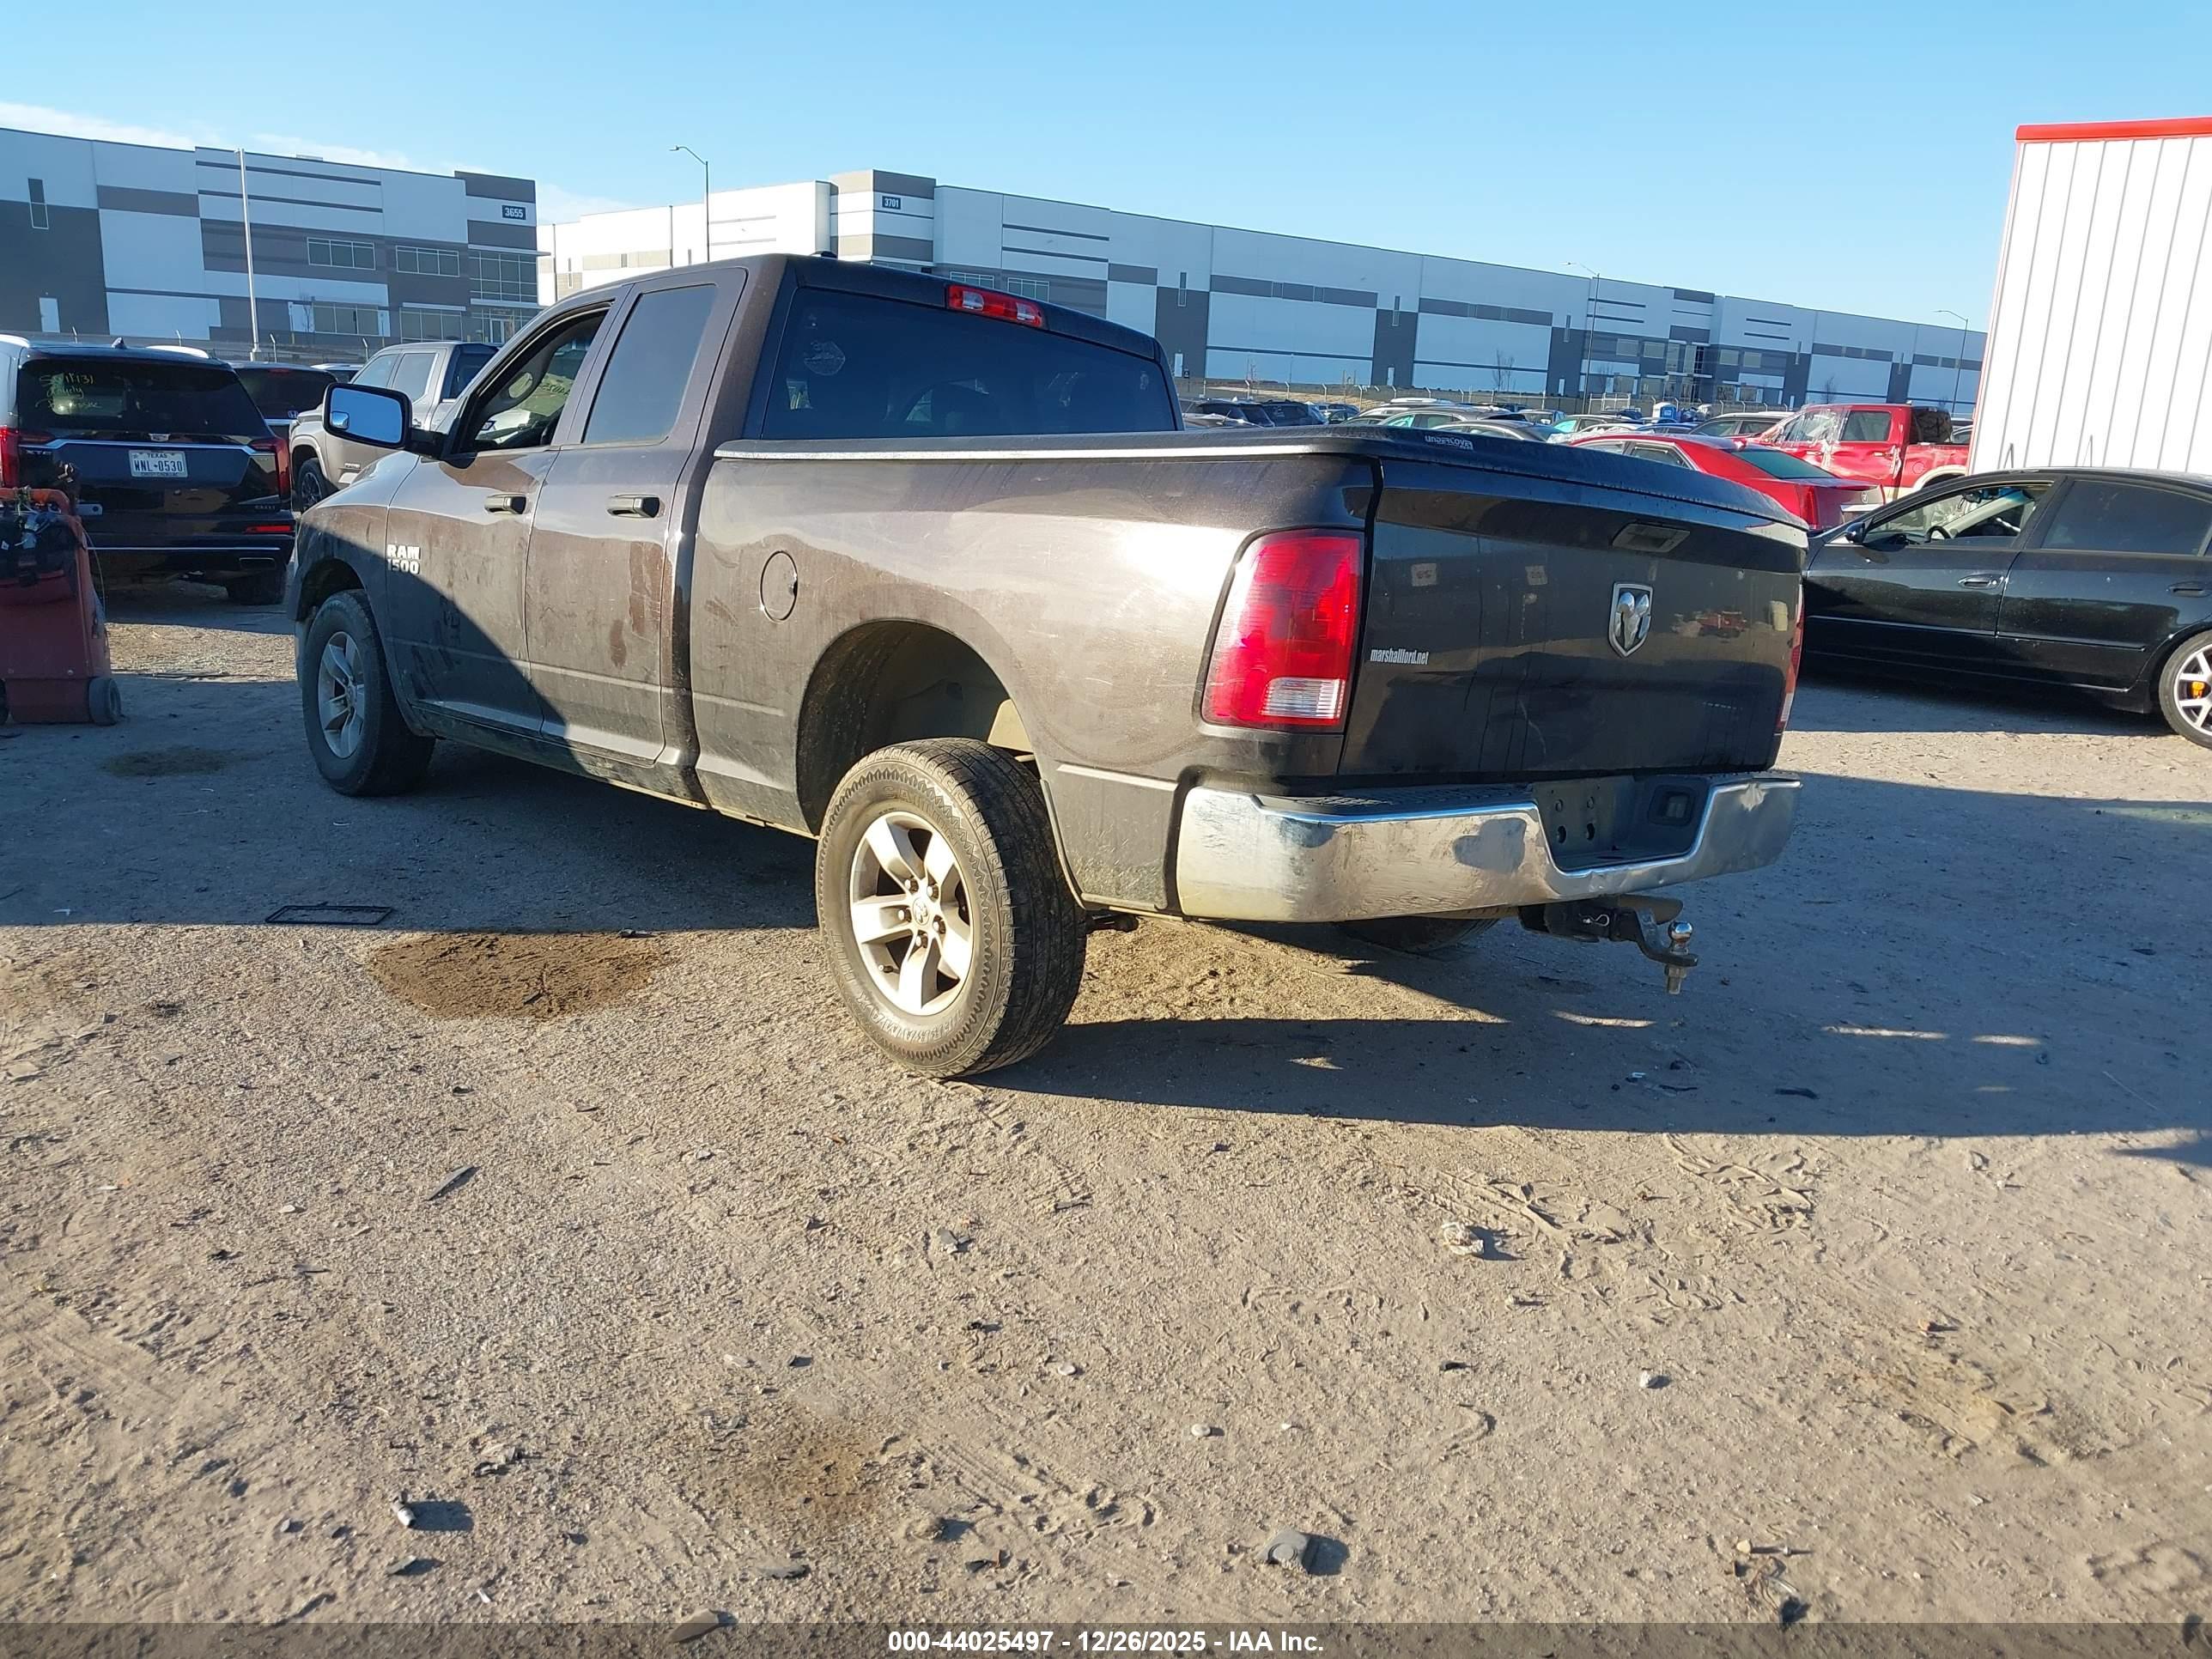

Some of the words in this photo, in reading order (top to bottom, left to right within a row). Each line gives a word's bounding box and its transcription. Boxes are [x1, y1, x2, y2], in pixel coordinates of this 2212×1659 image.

[884, 198, 899, 209] 3701
[505, 207, 524, 218] 3655
[387, 544, 420, 560] RAM
[387, 558, 420, 574] 1500
[1370, 647, 1429, 665] marshallford.net
